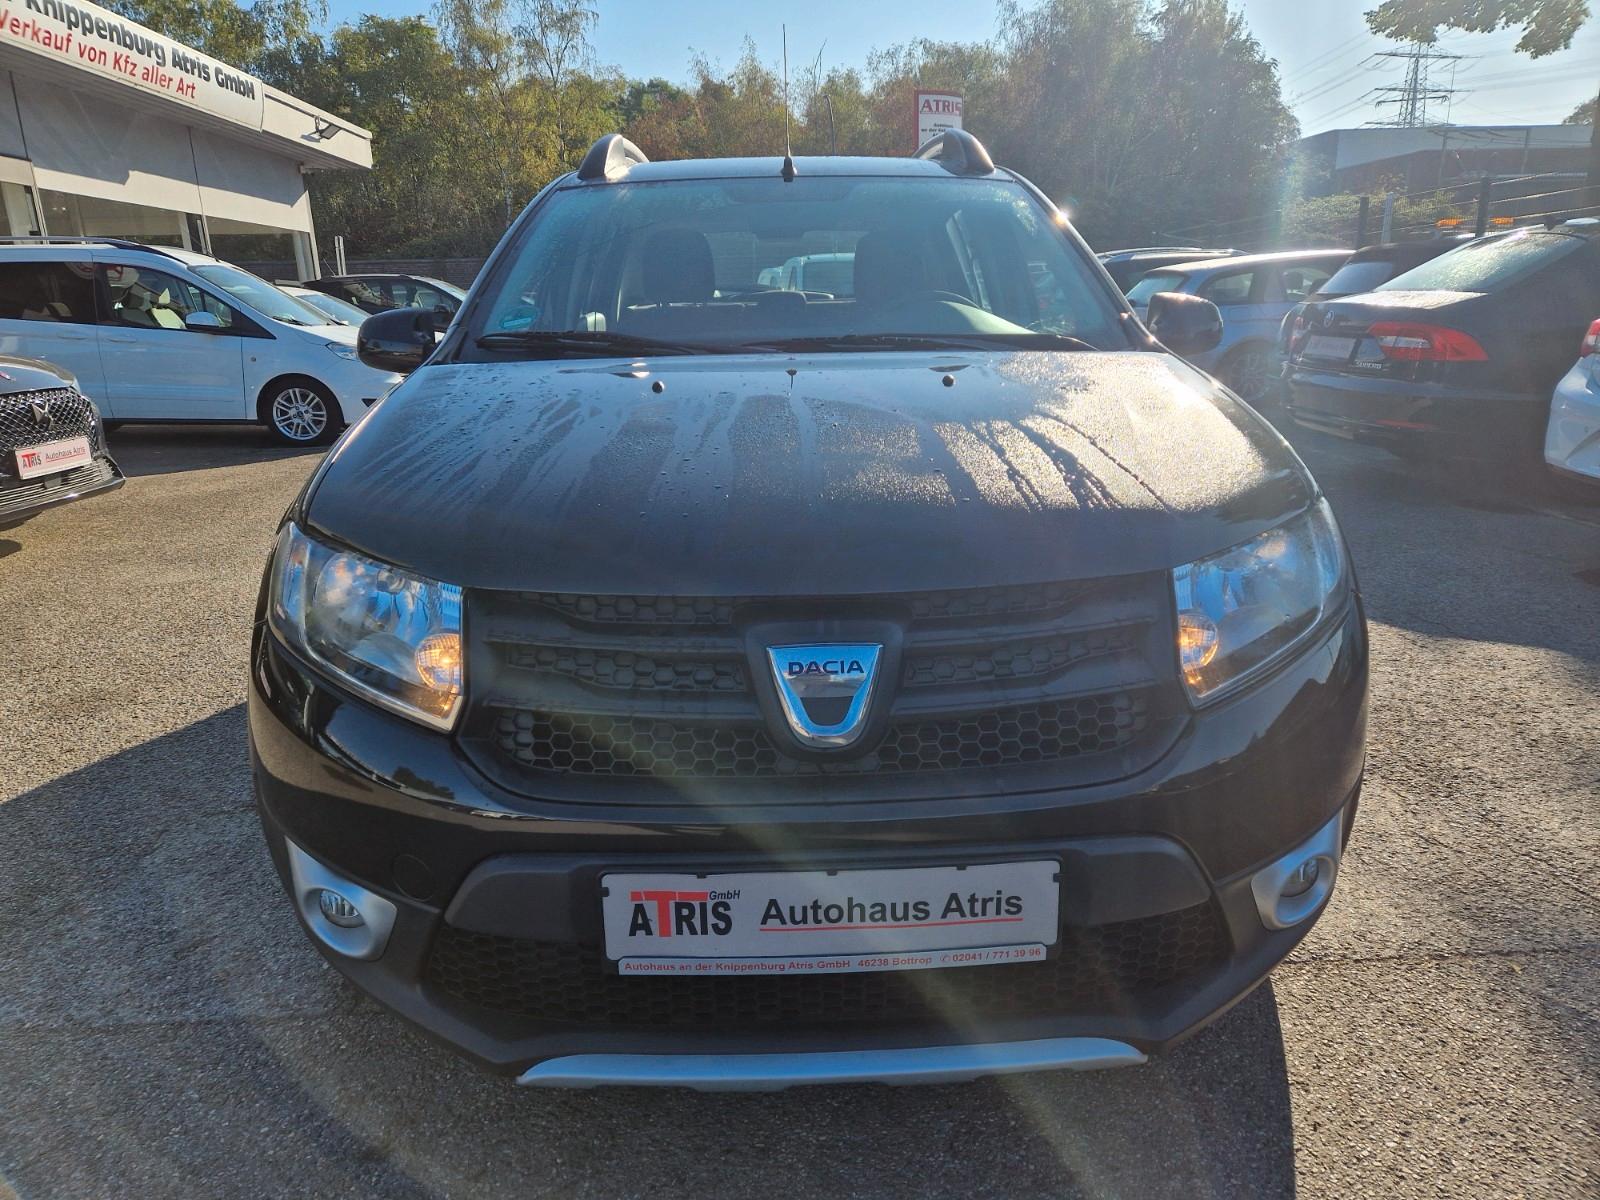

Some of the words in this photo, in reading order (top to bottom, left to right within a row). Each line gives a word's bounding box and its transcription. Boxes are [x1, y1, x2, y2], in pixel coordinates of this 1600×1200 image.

[78, 42, 107, 66] von
[113, 51, 138, 77] Kfz
[141, 65, 173, 90] aller
[176, 78, 196, 99] Art
[171, 48, 211, 82] Atris
[214, 66, 255, 100] GmbH
[21, 452, 42, 468] ATRIS
[787, 659, 865, 675] DACIA
[709, 889, 741, 901] GmbH
[628, 891, 733, 937] ATRIS
[760, 896, 930, 926] Autohaus
[940, 889, 1023, 920] Atris
[624, 962, 676, 971] Autohaus
[679, 964, 693, 972] an
[695, 962, 713, 971] der
[718, 962, 785, 972] Knippenburg
[788, 960, 813, 970] Atris
[817, 959, 850, 969] GmbH
[857, 958, 889, 968] 46238
[892, 956, 932, 967] Bottrop
[952, 953, 983, 962] 02041
[992, 950, 1011, 959] 771
[1014, 949, 1026, 958] 39
[1029, 947, 1041, 957] 96
